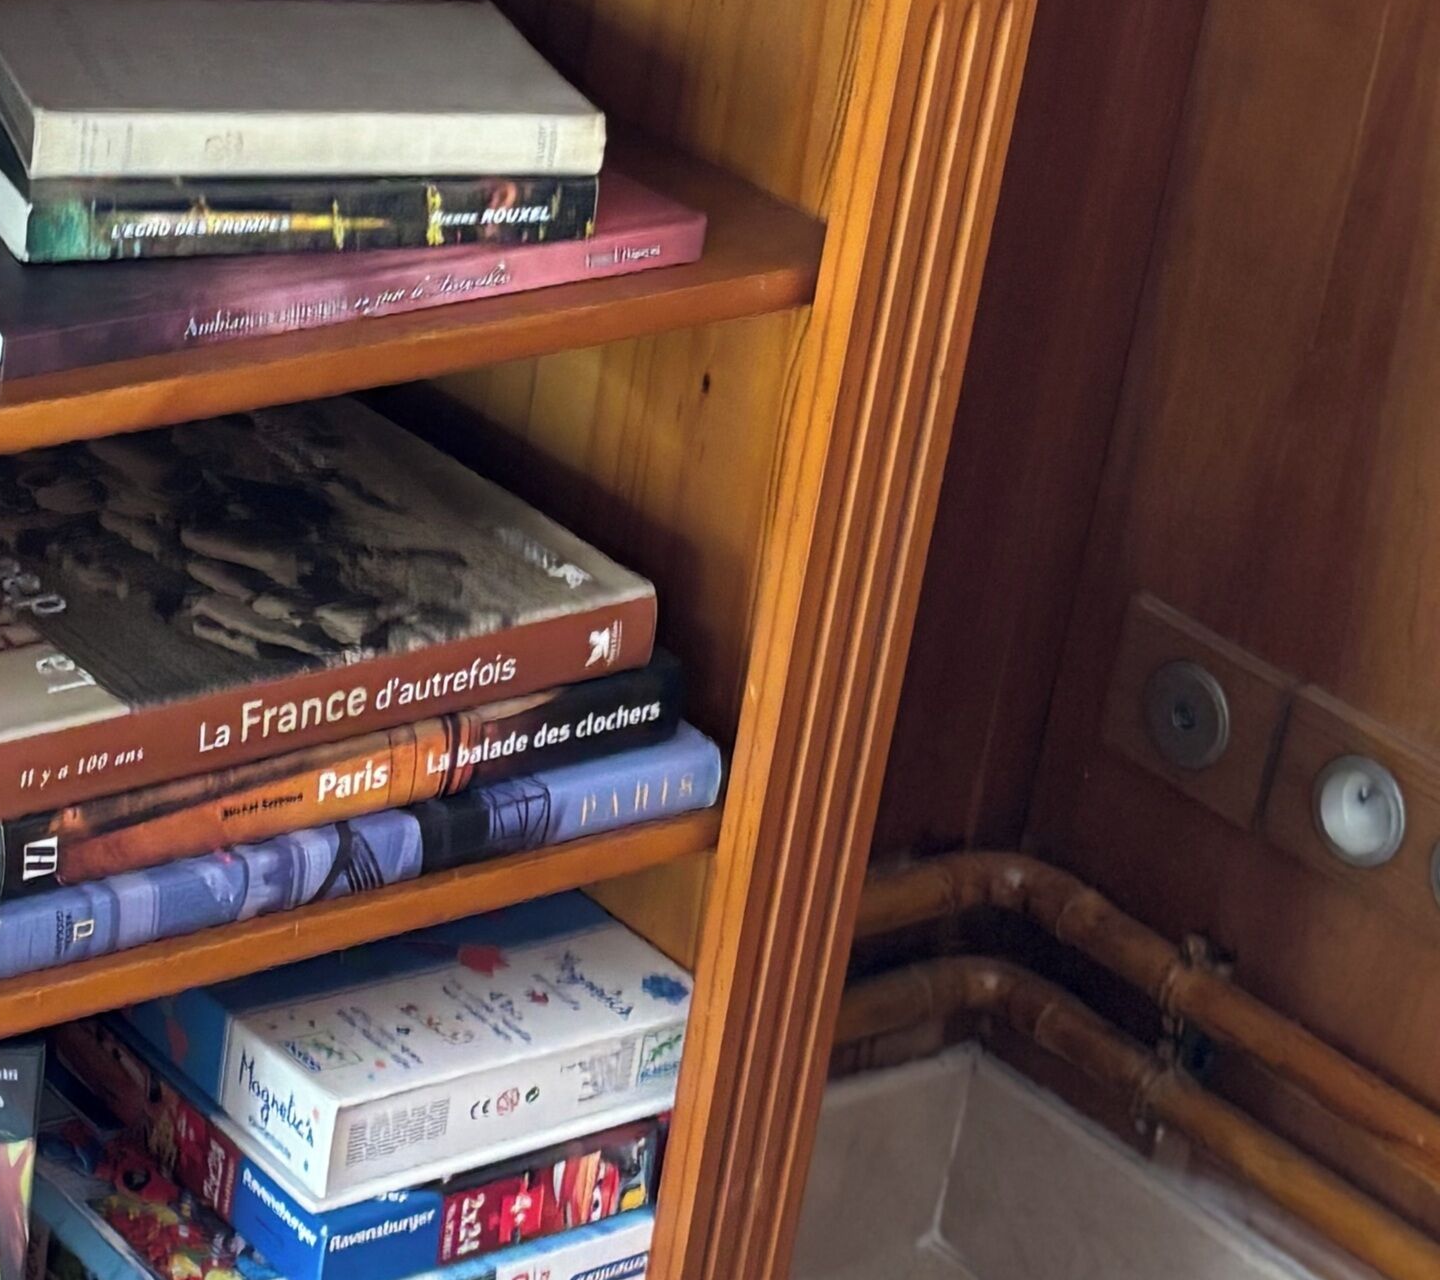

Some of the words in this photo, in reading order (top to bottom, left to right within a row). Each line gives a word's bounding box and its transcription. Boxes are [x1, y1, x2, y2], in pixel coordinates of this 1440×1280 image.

[480, 204, 552, 226] ROUXEL
[34, 653, 98, 695] La
[198, 719, 231, 753] La
[240, 686, 368, 743] France
[374, 652, 518, 712] d'autrefois
[39, 770, 51, 792] y
[77, 751, 109, 777] 100
[114, 746, 145, 767] ans
[316, 759, 390, 803] Paris
[426, 750, 448, 776] La
[456, 731, 528, 769] balade
[532, 718, 571, 749] des
[574, 698, 661, 739] clochers
[328, 1208, 436, 1253] Ravensburger
[457, 1191, 486, 1257] 2x24
